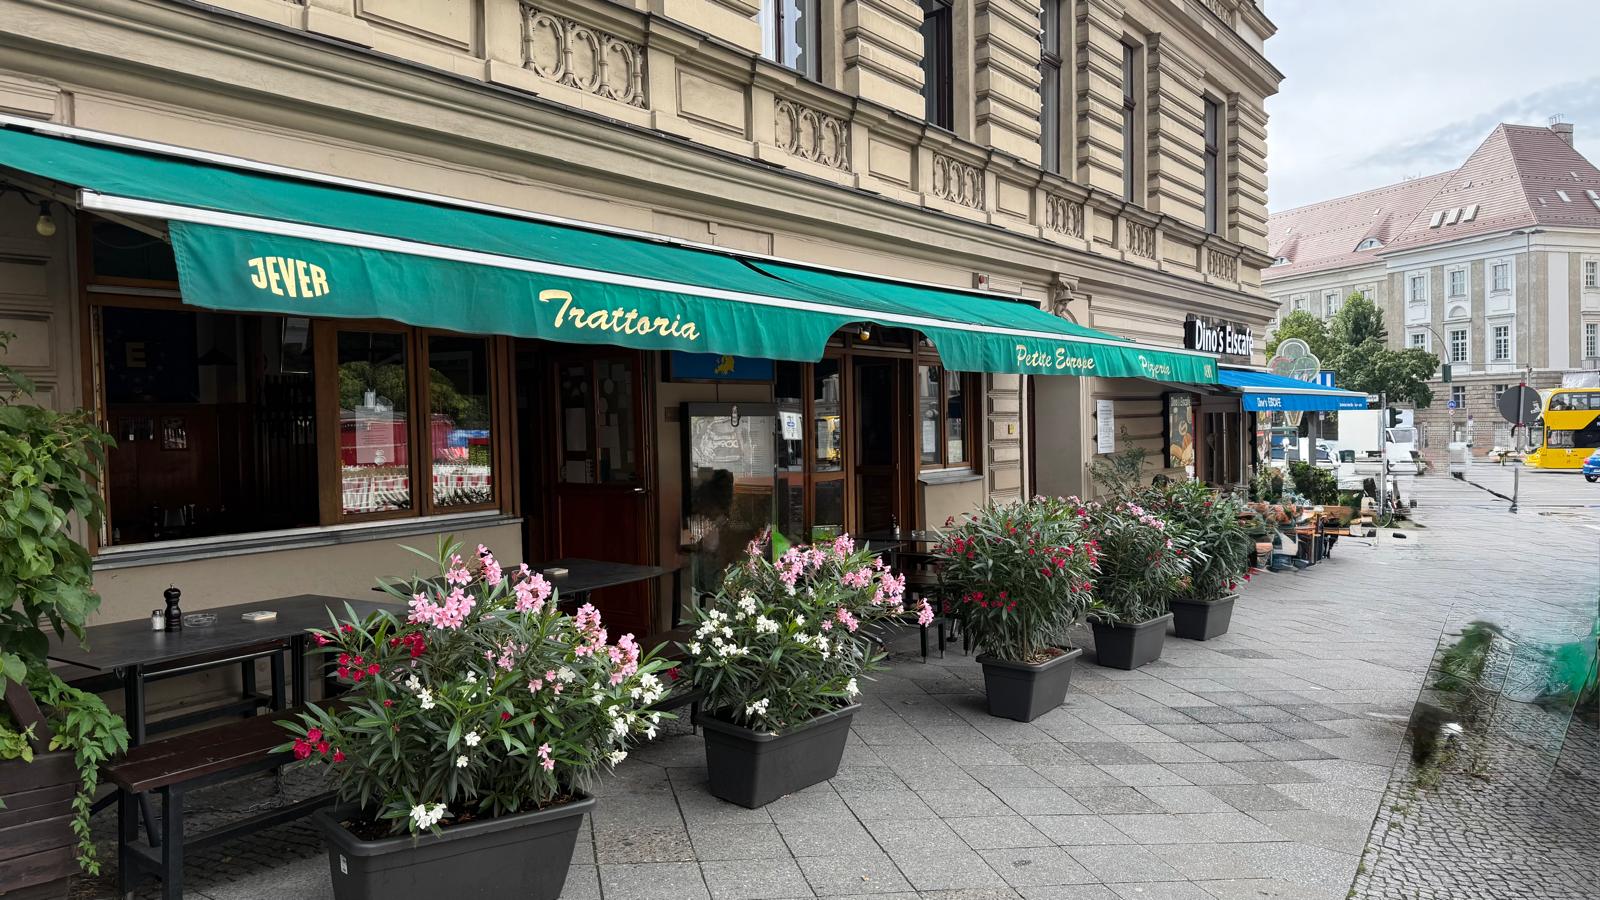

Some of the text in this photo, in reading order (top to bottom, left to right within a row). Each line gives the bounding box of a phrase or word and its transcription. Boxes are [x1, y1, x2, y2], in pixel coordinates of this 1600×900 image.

[248, 256, 330, 298] JEVER
[539, 289, 700, 340] Trattoria
[1016, 344, 1095, 371] Petite Europe
